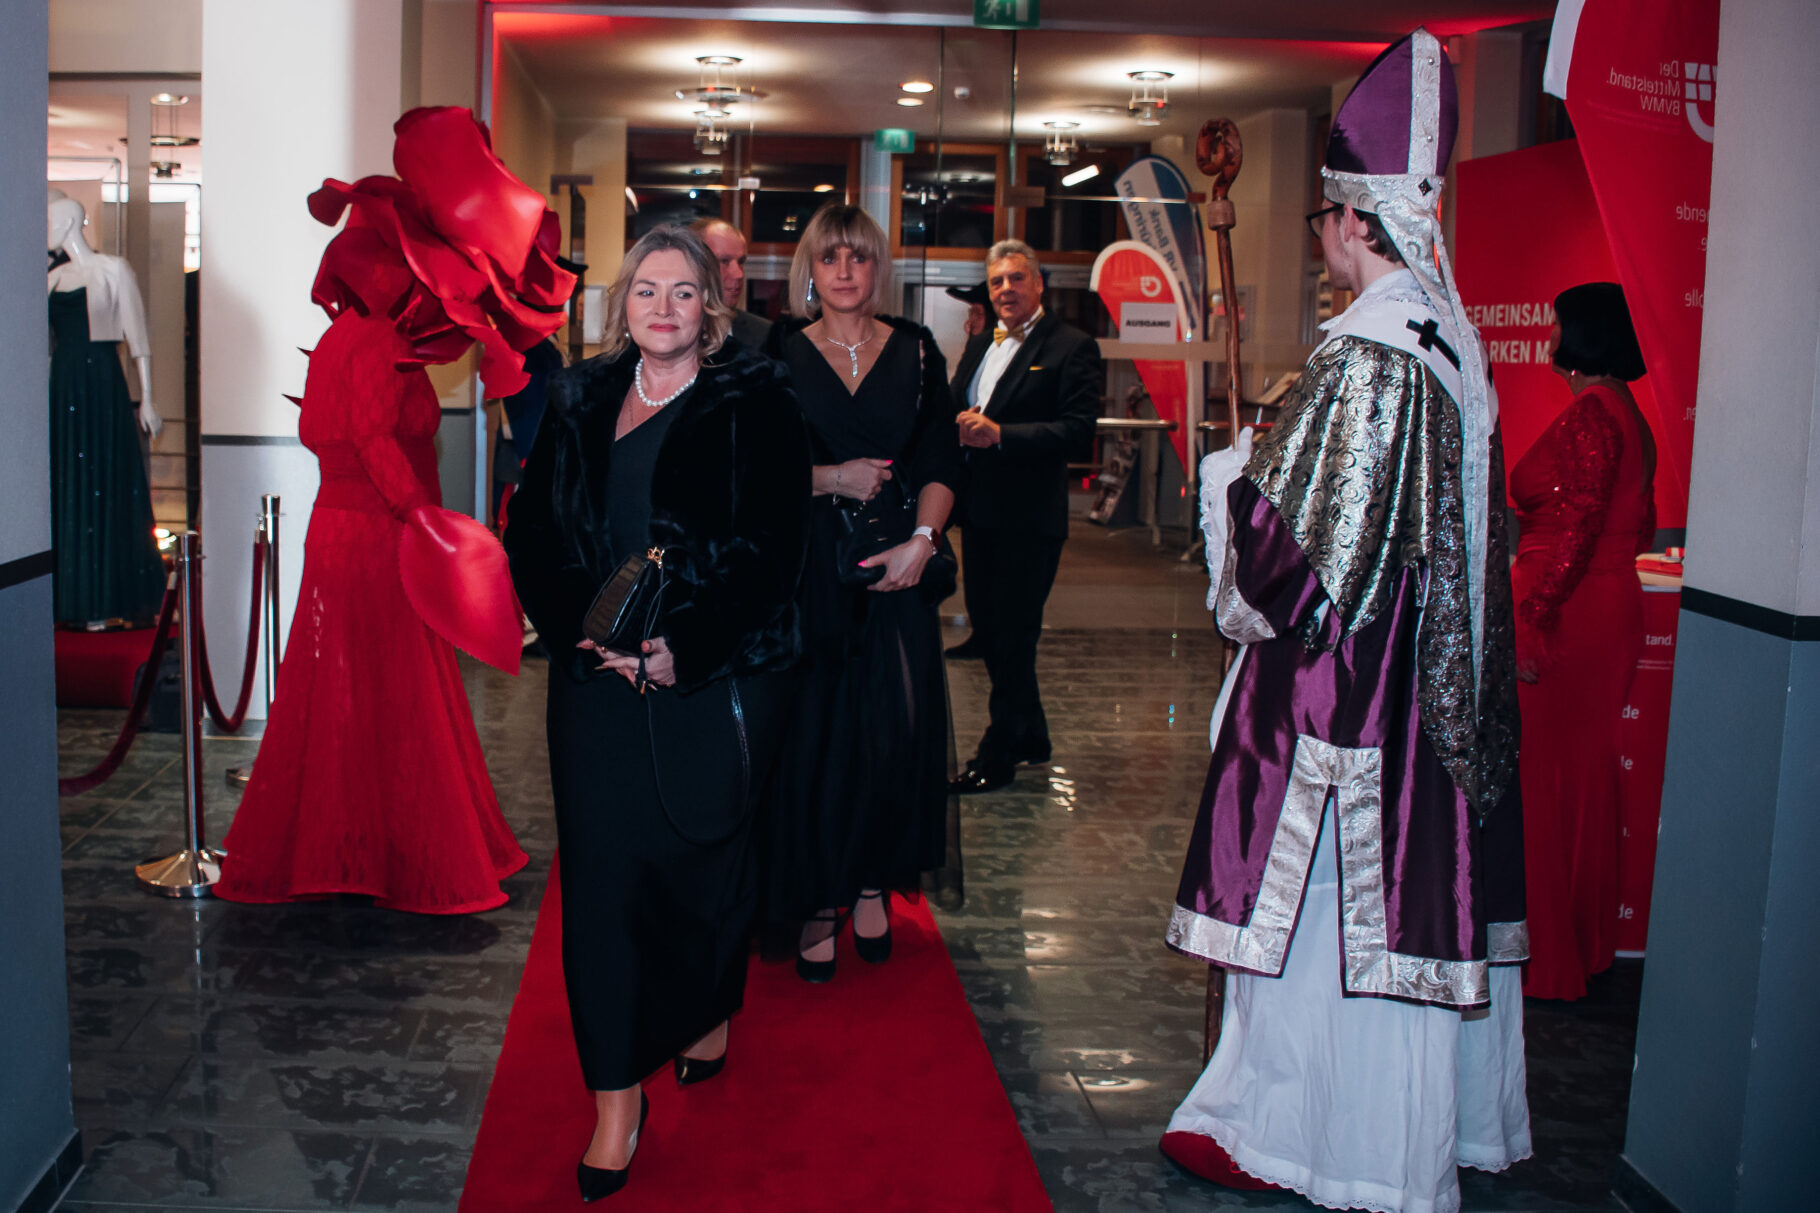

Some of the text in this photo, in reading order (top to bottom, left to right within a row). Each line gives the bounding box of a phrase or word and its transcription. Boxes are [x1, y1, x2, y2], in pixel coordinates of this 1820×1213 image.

[1465, 302, 1556, 328] GEMEINSAM
[1487, 340, 1531, 364] RKEN
[1645, 633, 1674, 646] tand.
